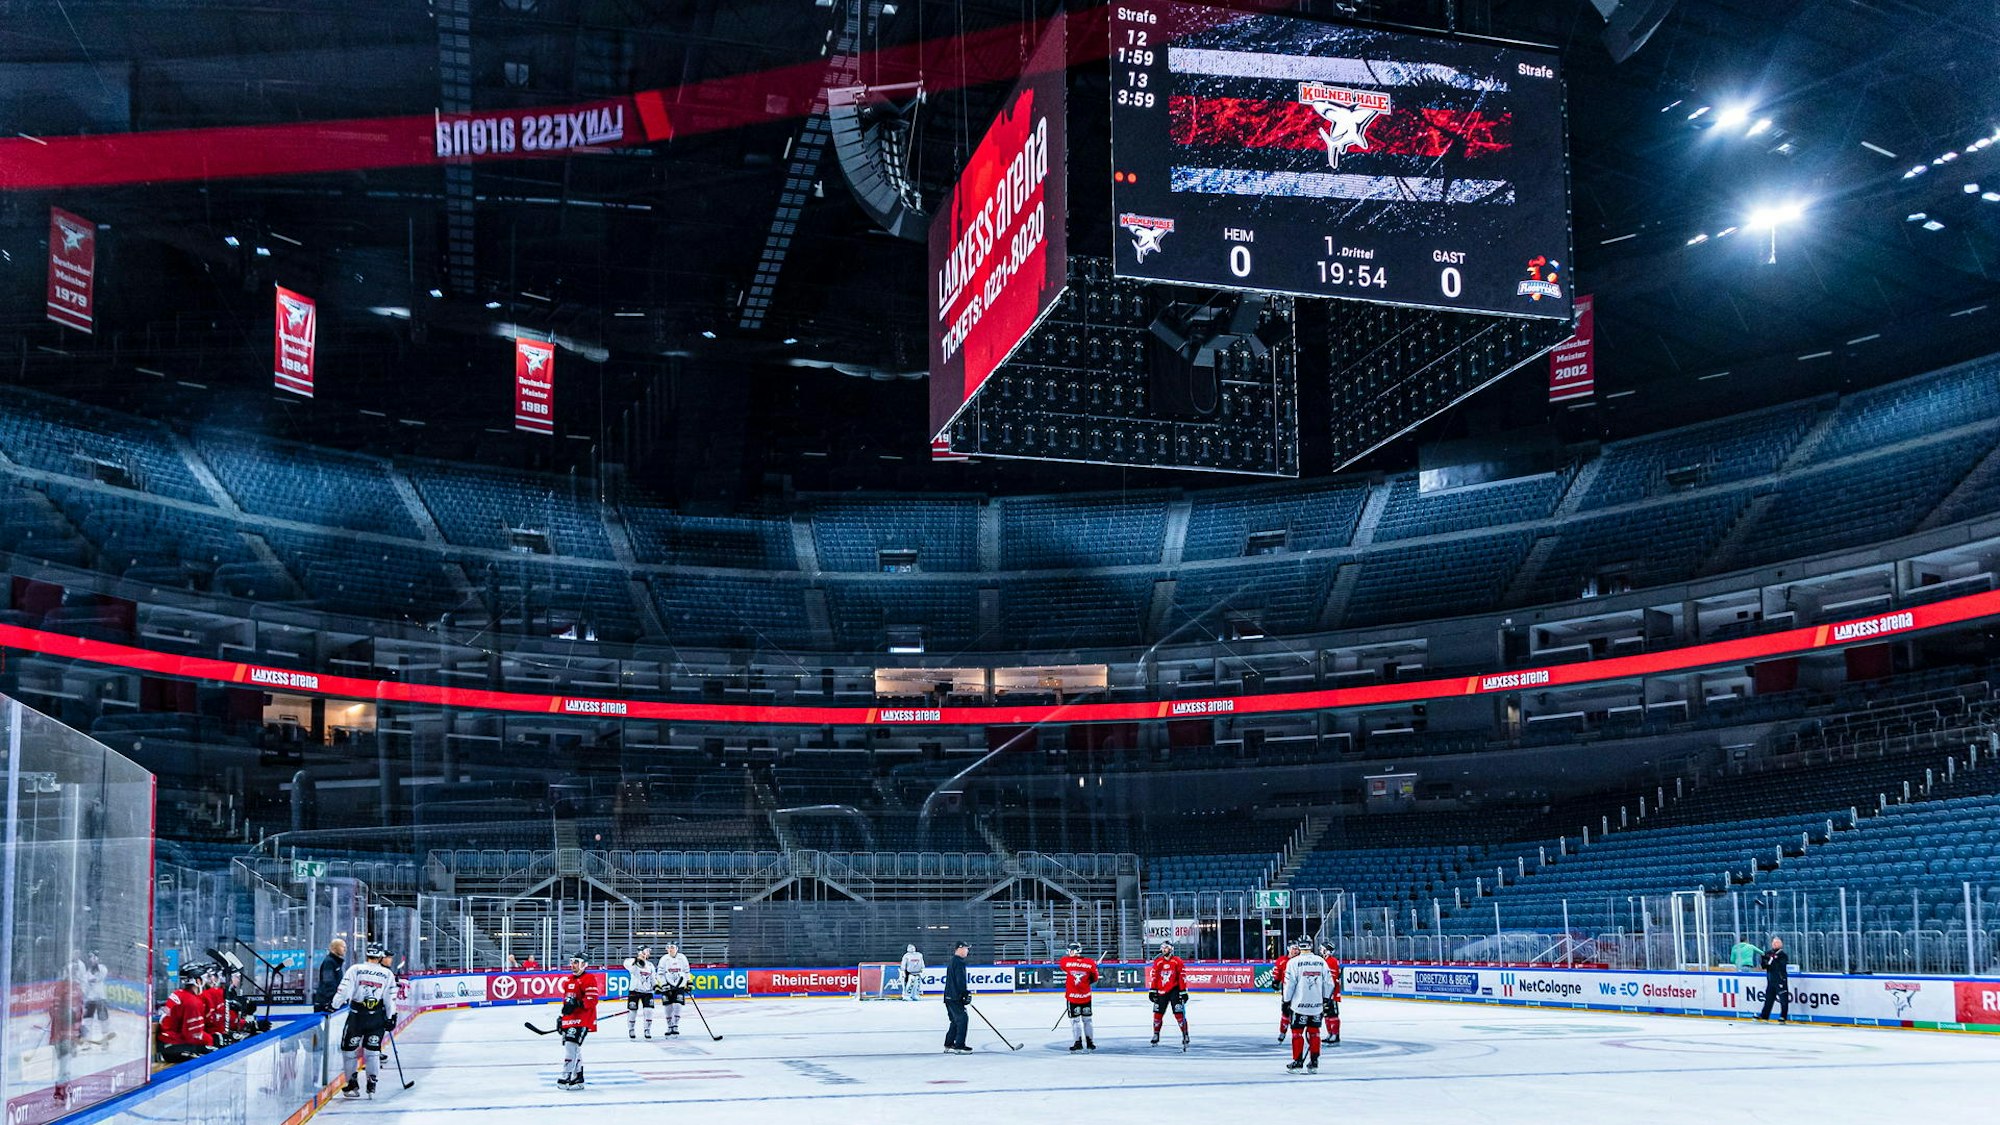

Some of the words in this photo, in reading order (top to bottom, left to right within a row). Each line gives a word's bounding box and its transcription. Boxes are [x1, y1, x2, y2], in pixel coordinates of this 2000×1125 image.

[1117, 7, 1157, 24] Strafe
[1127, 29, 1147, 46] 12
[1118, 47, 1154, 66] 1:59
[1128, 71, 1148, 88] 13
[1518, 63, 1554, 79] Strafe
[1117, 89, 1155, 108] 3:59
[1302, 83, 1351, 104] KÖLNER
[1356, 91, 1388, 111] HAIE
[938, 196, 994, 321] LANXESS
[996, 116, 1048, 240] arena
[1224, 228, 1254, 242] HEIM
[1230, 245, 1251, 277] 0
[1433, 250, 1466, 264] GAST
[941, 293, 982, 364] TICKETS:
[983, 200, 1045, 310] 0221-8020
[1317, 261, 1387, 288] 19:54
[1441, 266, 1462, 298] 0
[55, 285, 87, 308] 1979
[281, 357, 309, 375] 1984
[1556, 352, 1587, 363] Meister
[1555, 363, 1588, 380] 2002
[521, 401, 549, 415] 1986
[1834, 619, 1879, 640] LANXESS
[1880, 612, 1913, 632] arena
[251, 668, 289, 686] LANXESS
[290, 673, 318, 689] arena
[1482, 674, 1520, 690] LANXESS
[1520, 670, 1549, 685] arena
[565, 699, 600, 713] LANXESS
[601, 702, 627, 714] arena
[1172, 702, 1207, 714] LANXESS
[1207, 700, 1234, 712] arena
[880, 710, 914, 721] LANXESS
[915, 710, 941, 721] arena
[772, 973, 858, 988] RheinEnergie
[1018, 970, 1041, 985] ETL
[1117, 969, 1141, 984] ETL
[1346, 970, 1380, 984] JONAS
[519, 976, 570, 995] TOYO
[1519, 979, 1582, 997] NetCologne
[1599, 982, 1617, 995] We
[1642, 984, 1697, 998] Glasfaser
[16, 1104, 29, 1124] OTT
